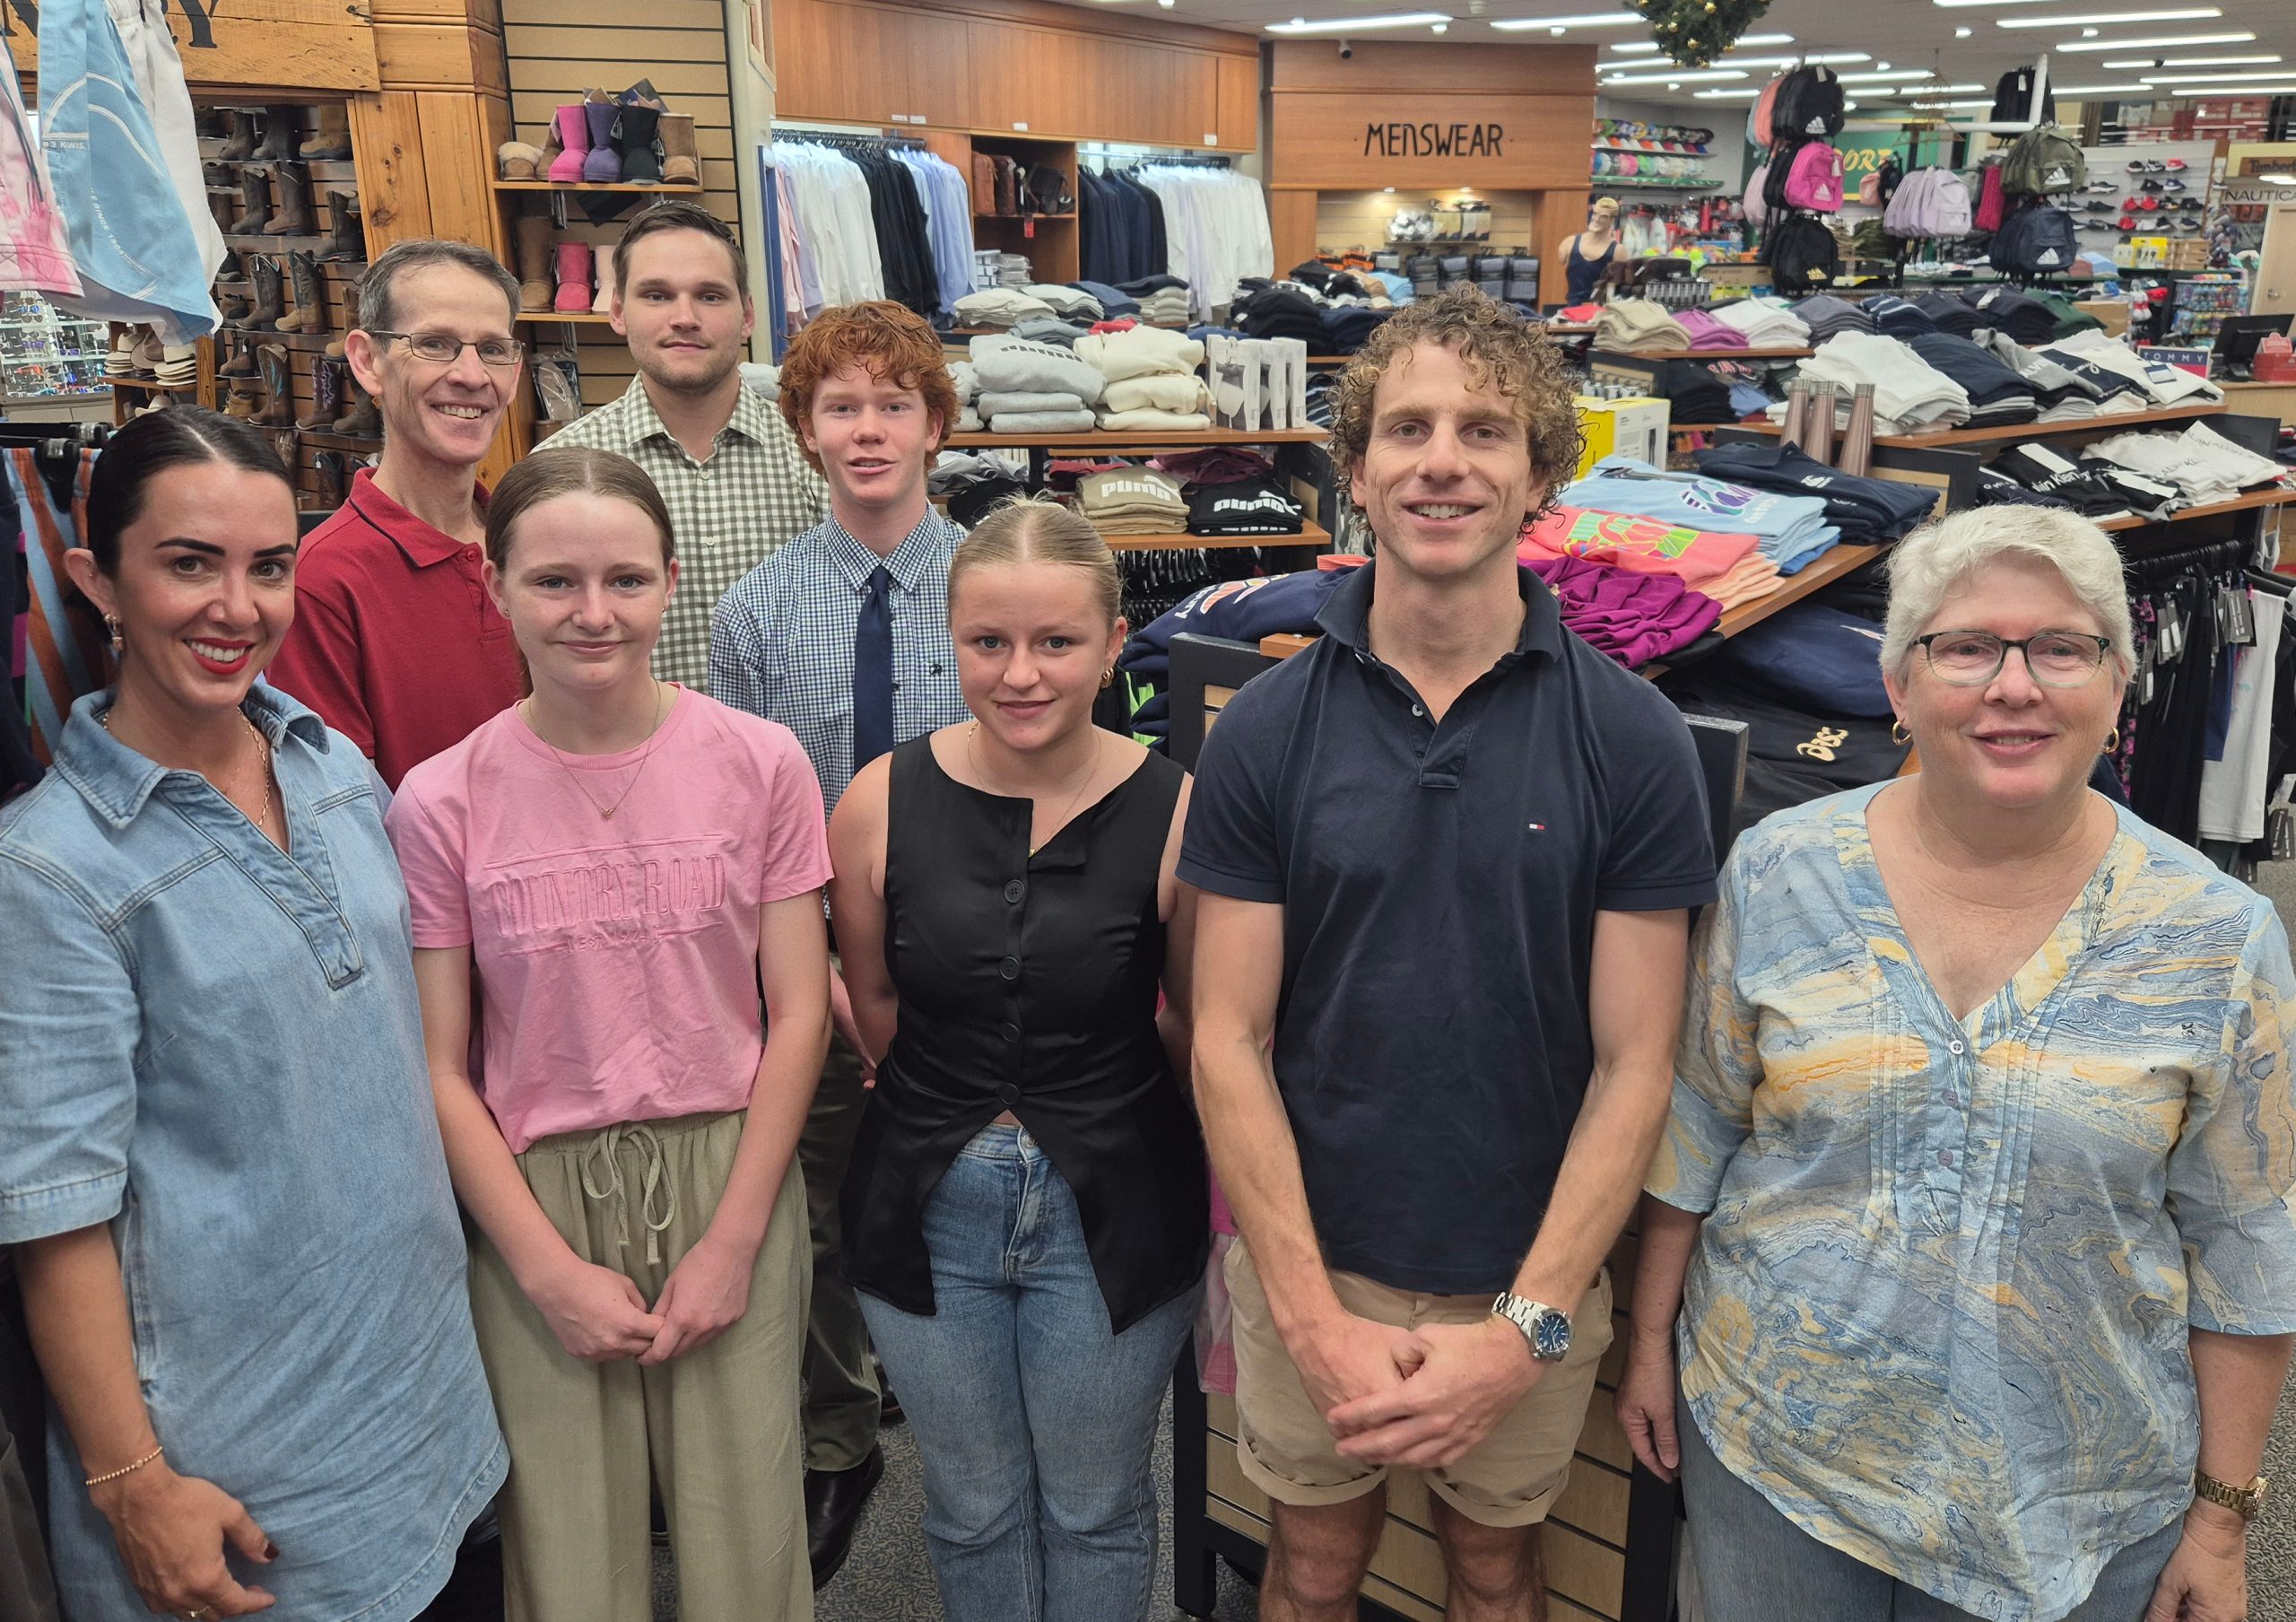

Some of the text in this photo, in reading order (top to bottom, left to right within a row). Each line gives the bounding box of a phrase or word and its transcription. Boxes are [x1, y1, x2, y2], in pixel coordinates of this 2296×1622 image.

[1364, 123, 1503, 156] MENSWEAR
[1833, 147, 1892, 171] ORT
[2144, 352, 2204, 363] TOMMY
[494, 853, 726, 938] COUNTRY ROAD
